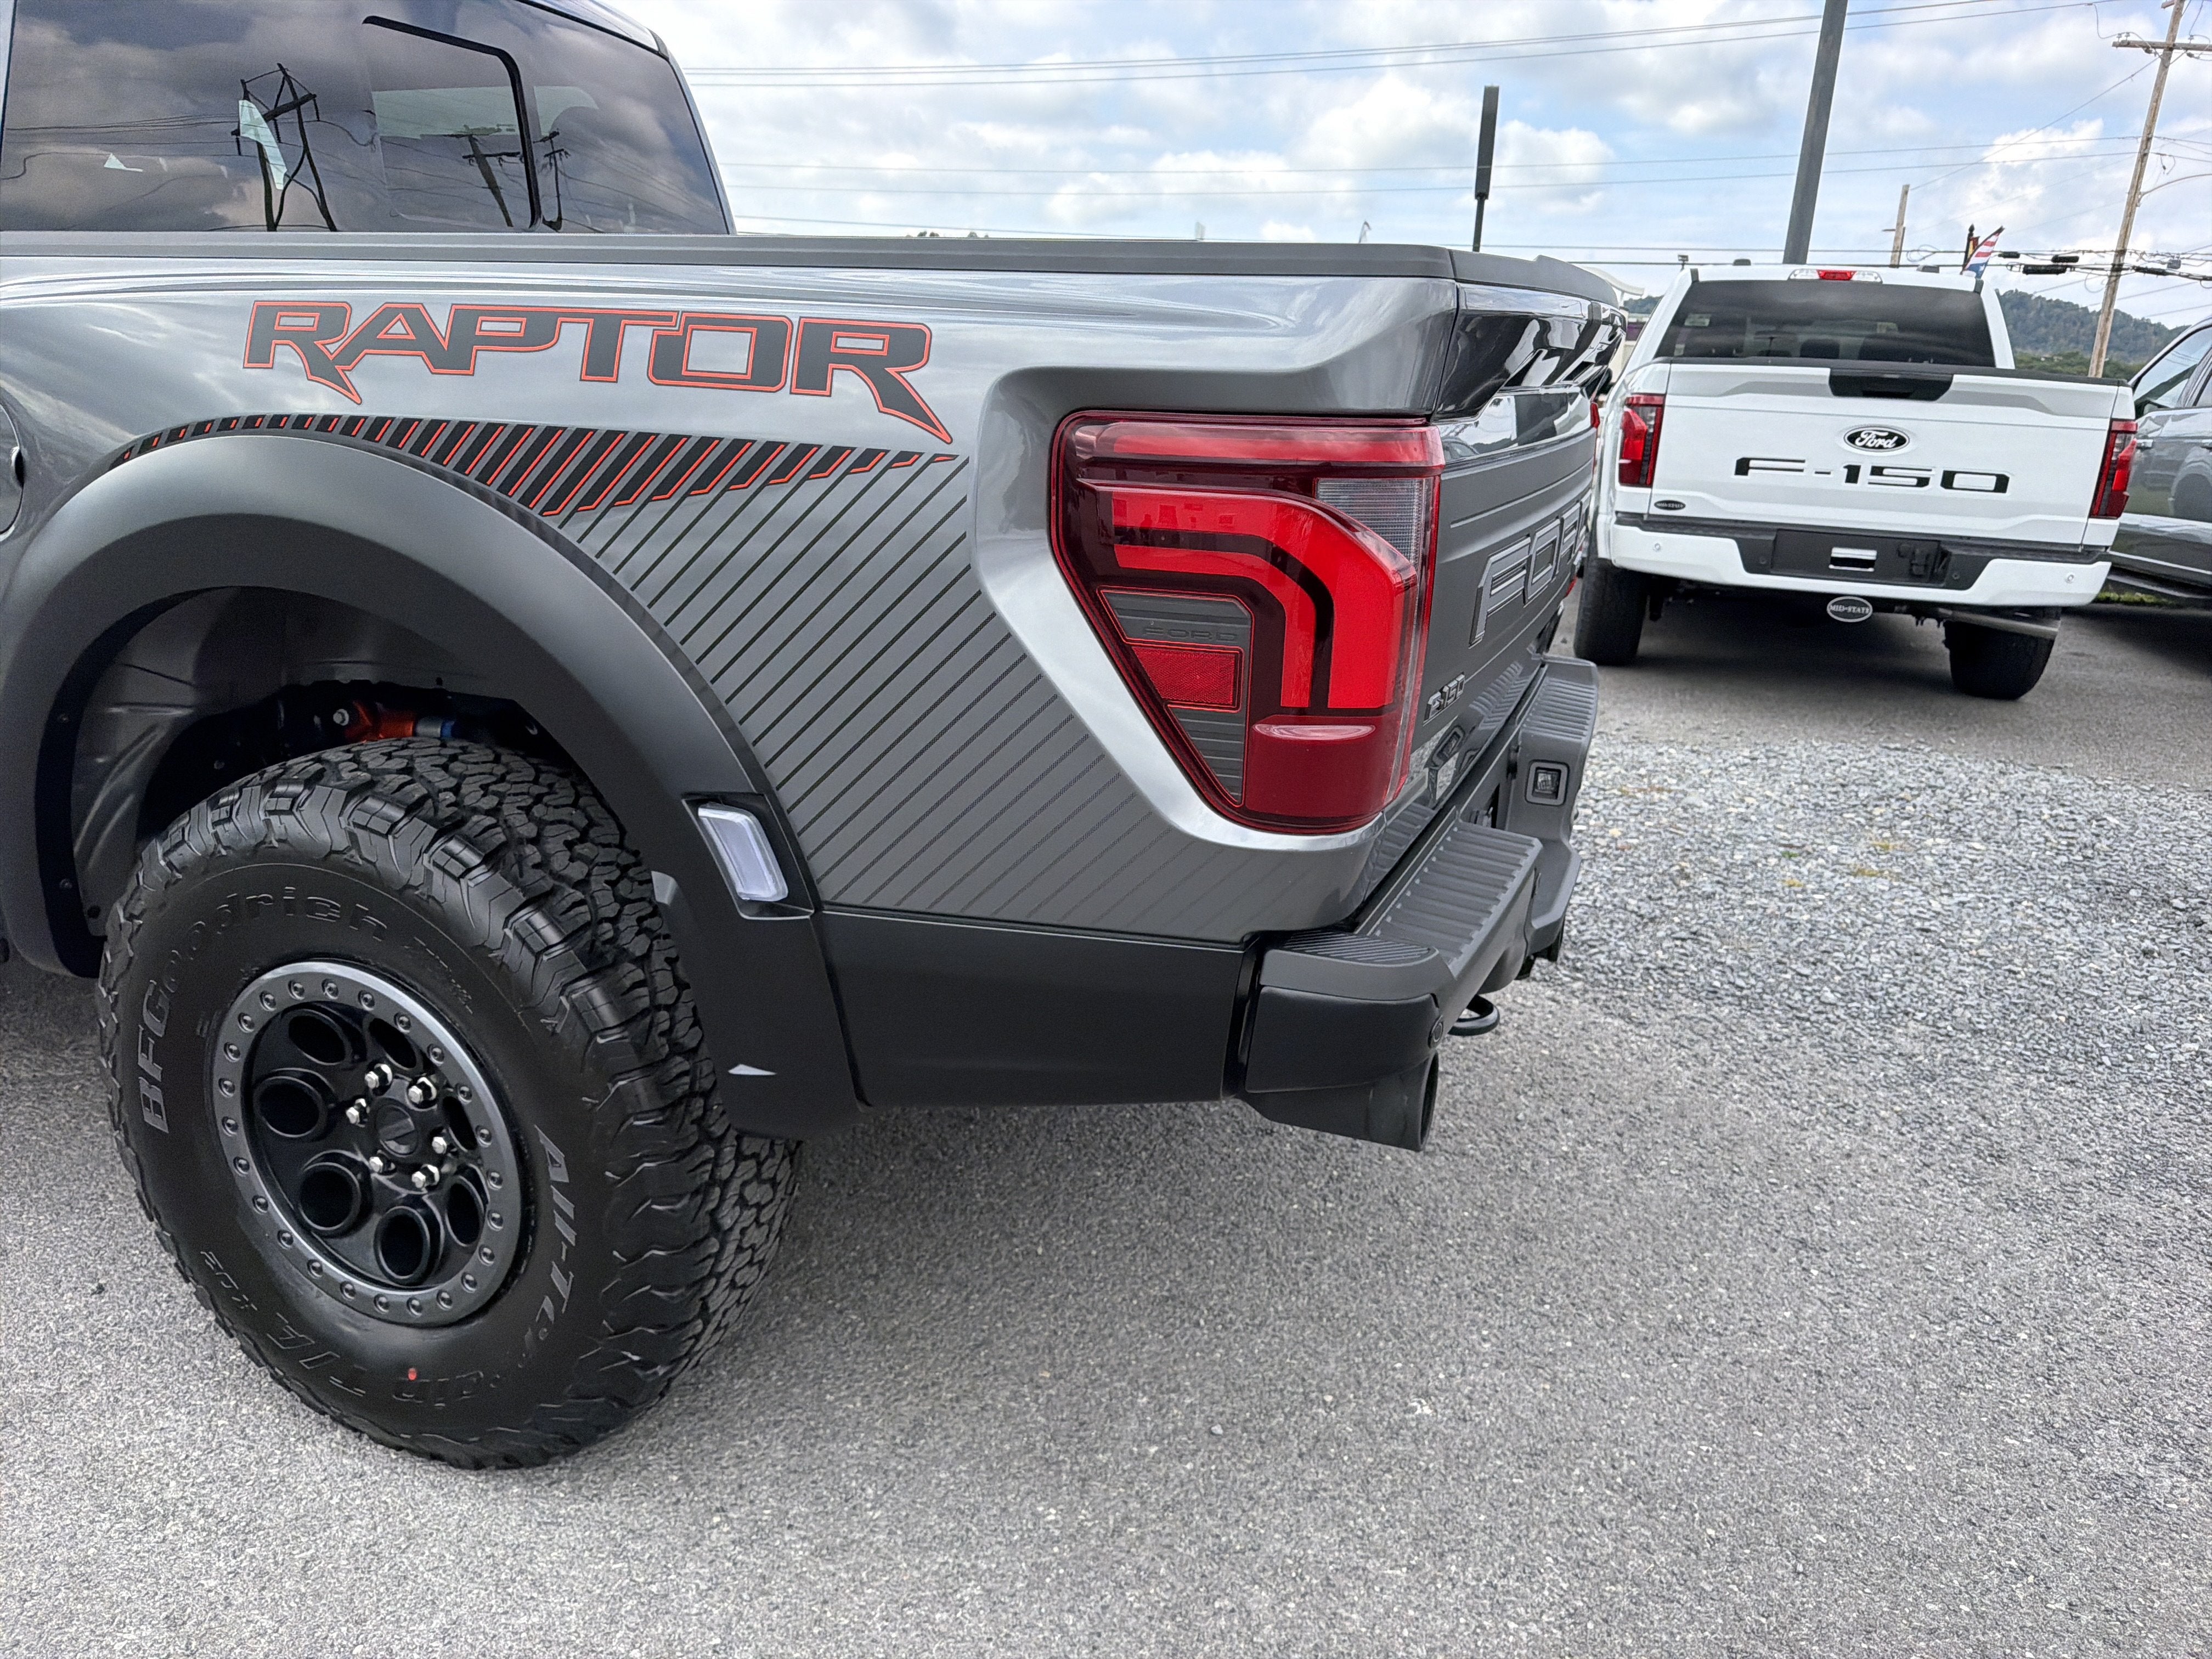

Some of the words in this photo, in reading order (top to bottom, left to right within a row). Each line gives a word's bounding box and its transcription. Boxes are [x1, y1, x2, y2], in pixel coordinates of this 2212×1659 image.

[242, 301, 951, 443] RAPTOR
[1855, 430, 1896, 449] Ford
[1734, 457, 2010, 494] F-150
[1830, 604, 1870, 614] MID-STATE
[1143, 626, 1238, 644] FORD
